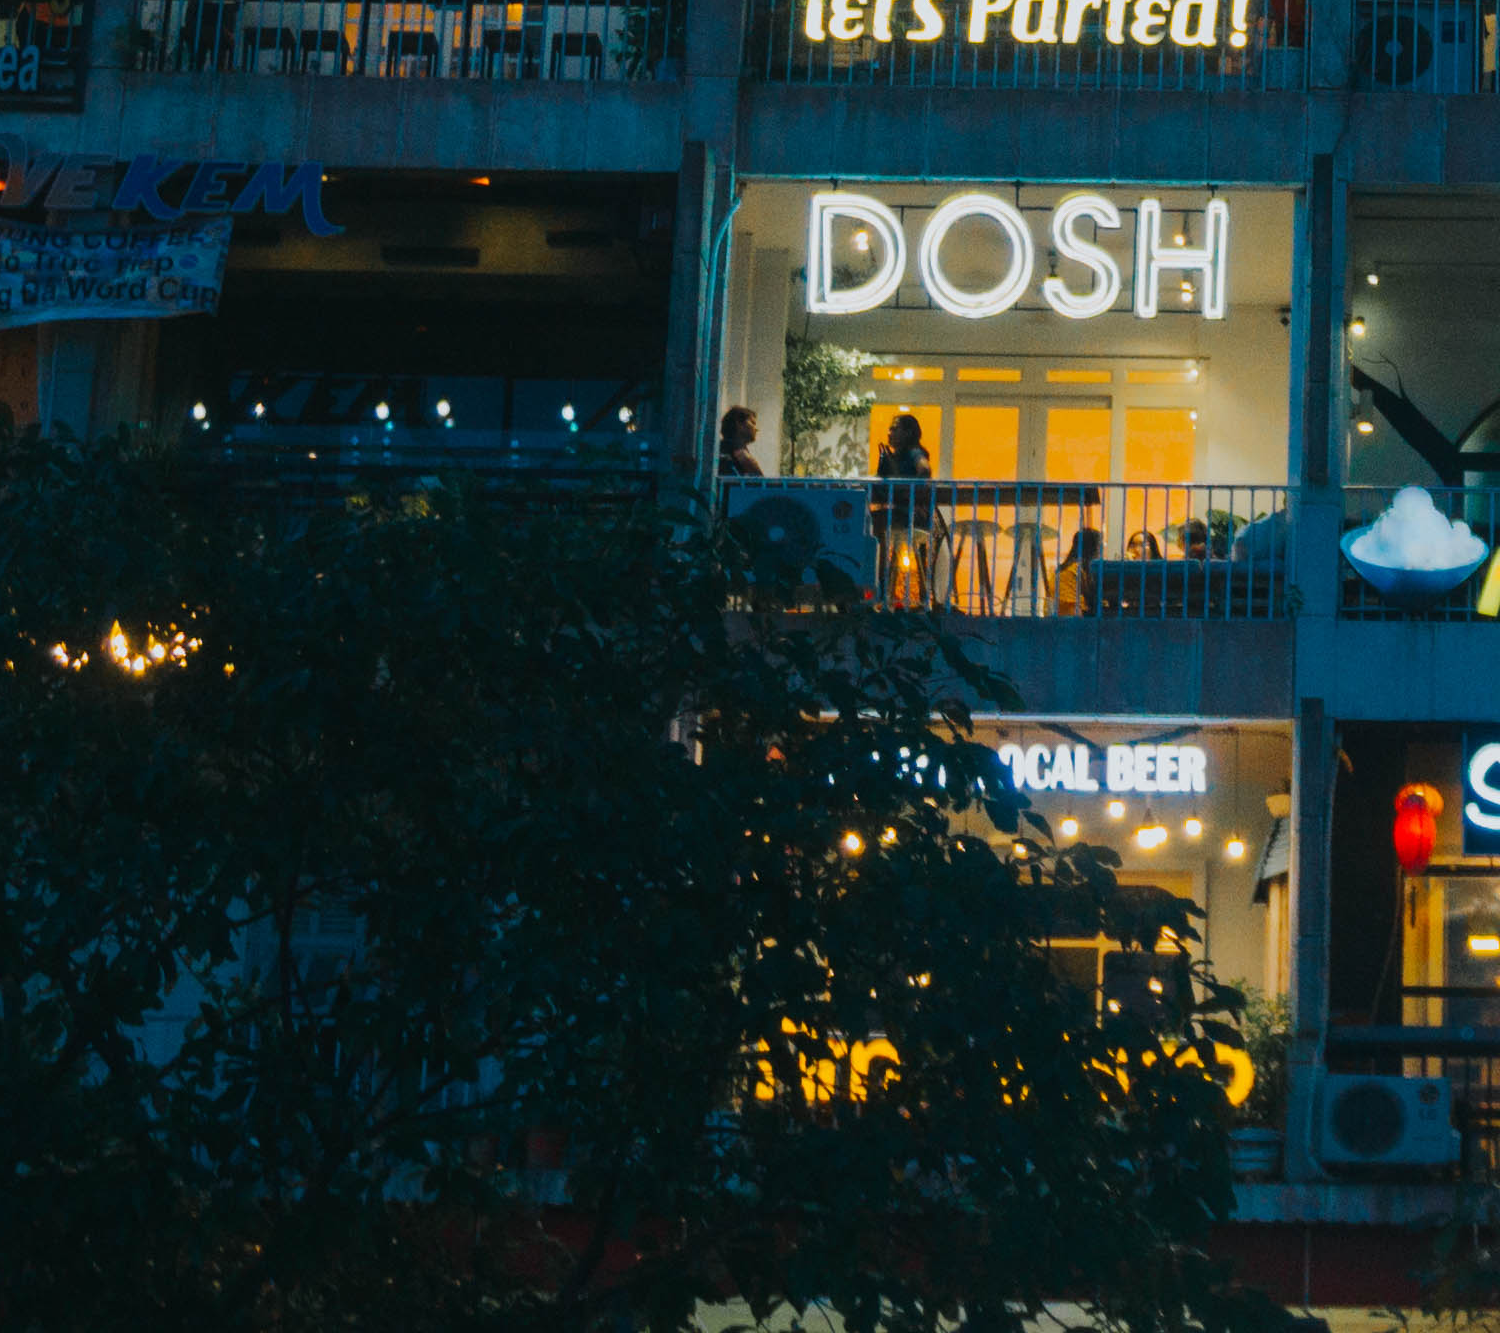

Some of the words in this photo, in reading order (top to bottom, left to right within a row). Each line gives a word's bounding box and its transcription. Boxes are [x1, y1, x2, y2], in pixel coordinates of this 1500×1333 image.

[112, 153, 347, 237] KEM
[807, 191, 1230, 320] DOSH
[1106, 744, 1208, 793] BEER
